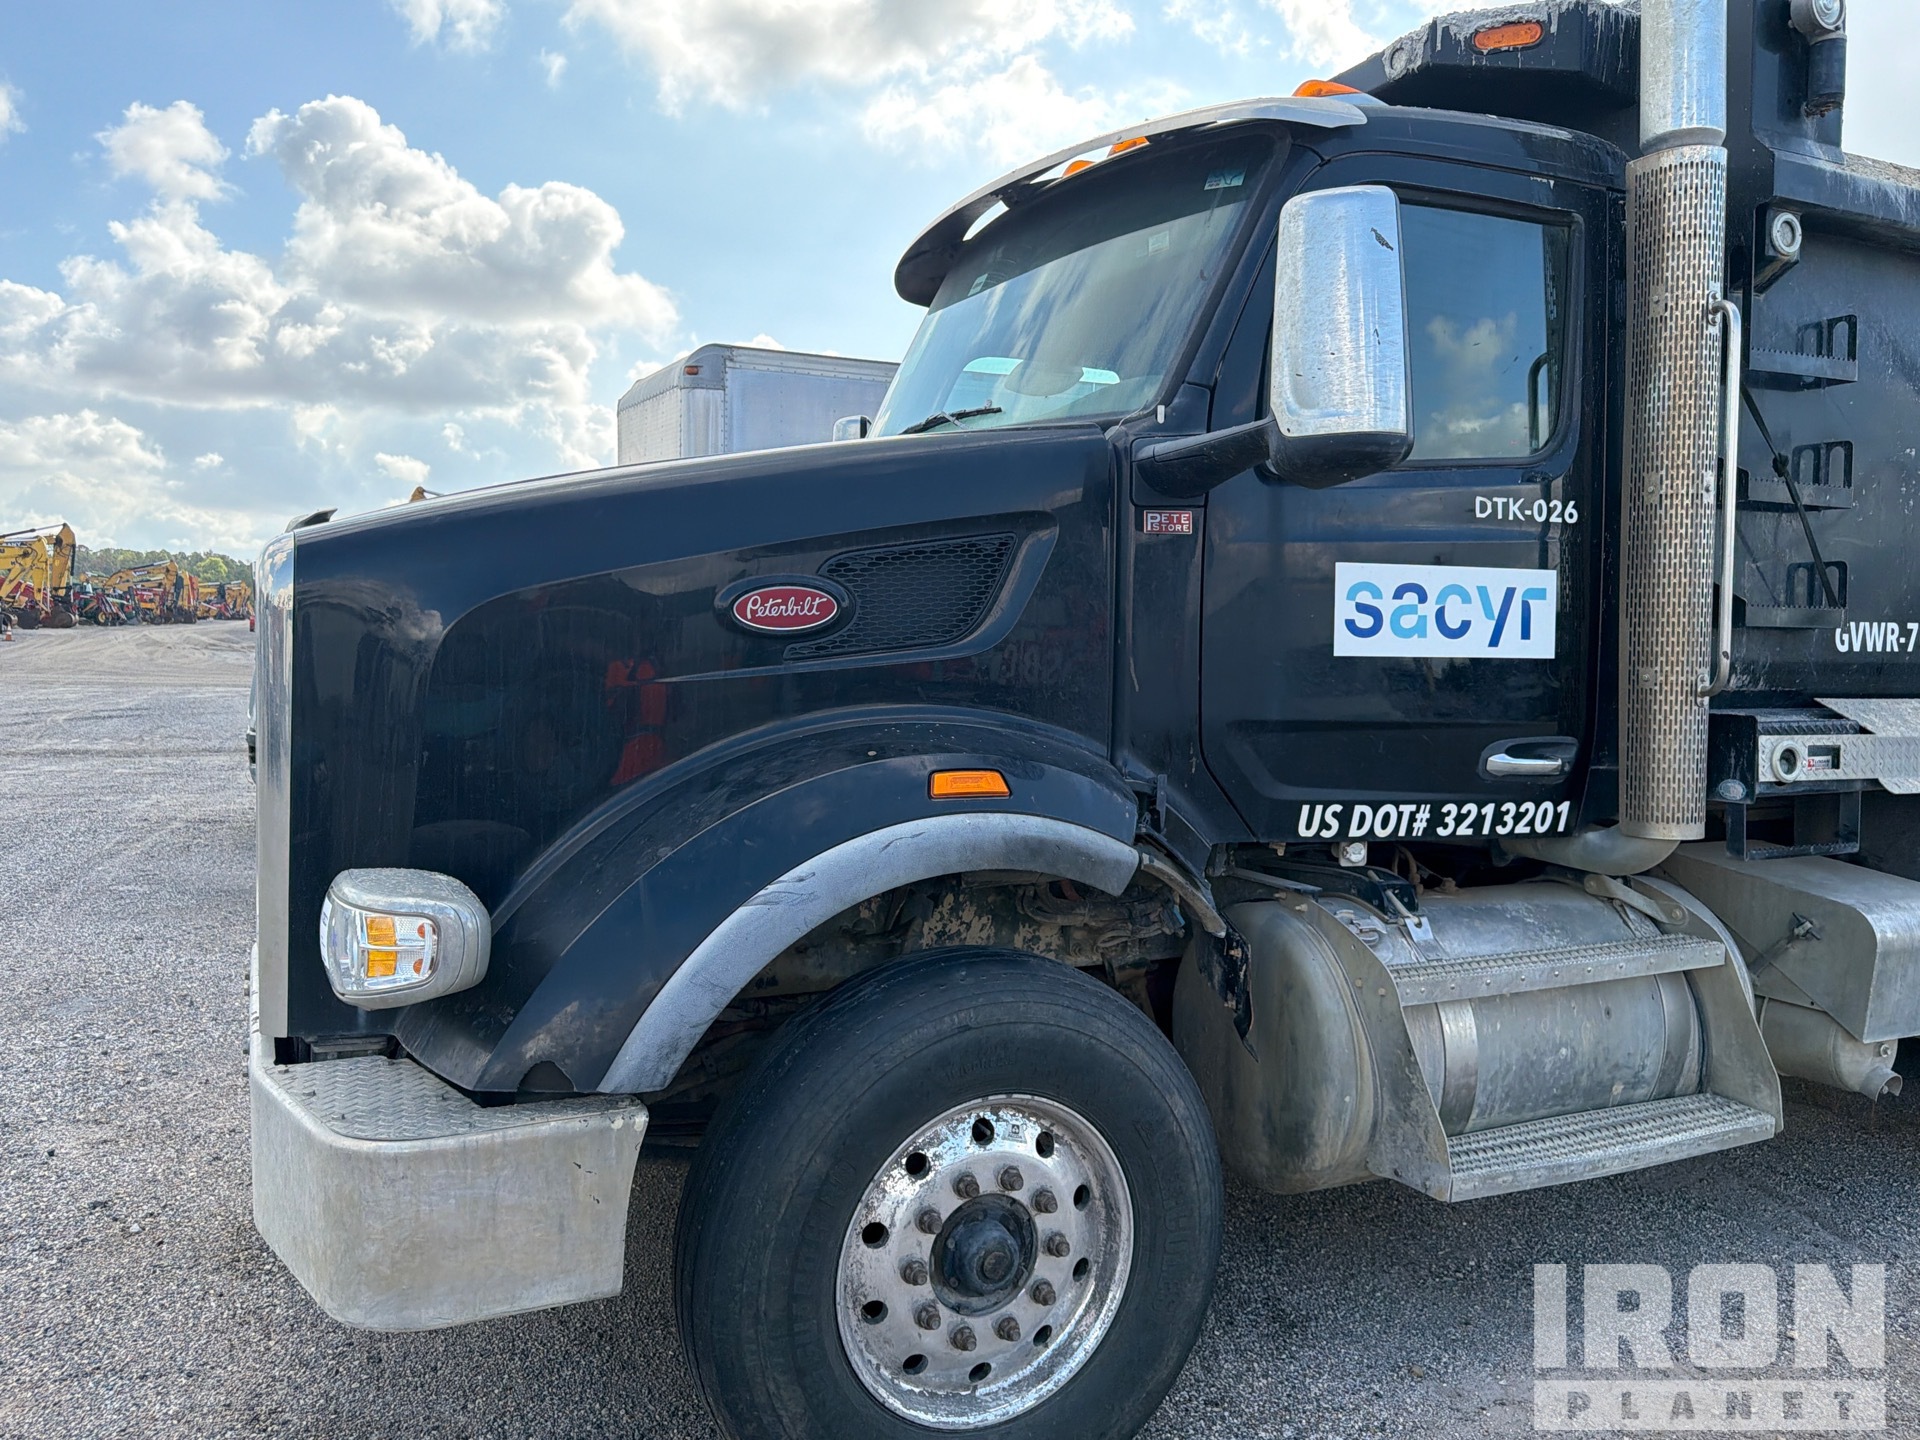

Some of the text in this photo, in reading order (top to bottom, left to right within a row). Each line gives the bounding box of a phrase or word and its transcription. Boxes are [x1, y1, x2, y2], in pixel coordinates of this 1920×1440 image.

[1147, 513, 1190, 531] PETE
[1475, 495, 1579, 524] DTK-026
[1153, 523, 1190, 532] STORE
[747, 595, 827, 620] Peterbilt
[1344, 581, 1548, 648] sacyr
[1835, 621, 1920, 653] GVWR-7
[1299, 800, 1570, 838] US DOT# 3213201
